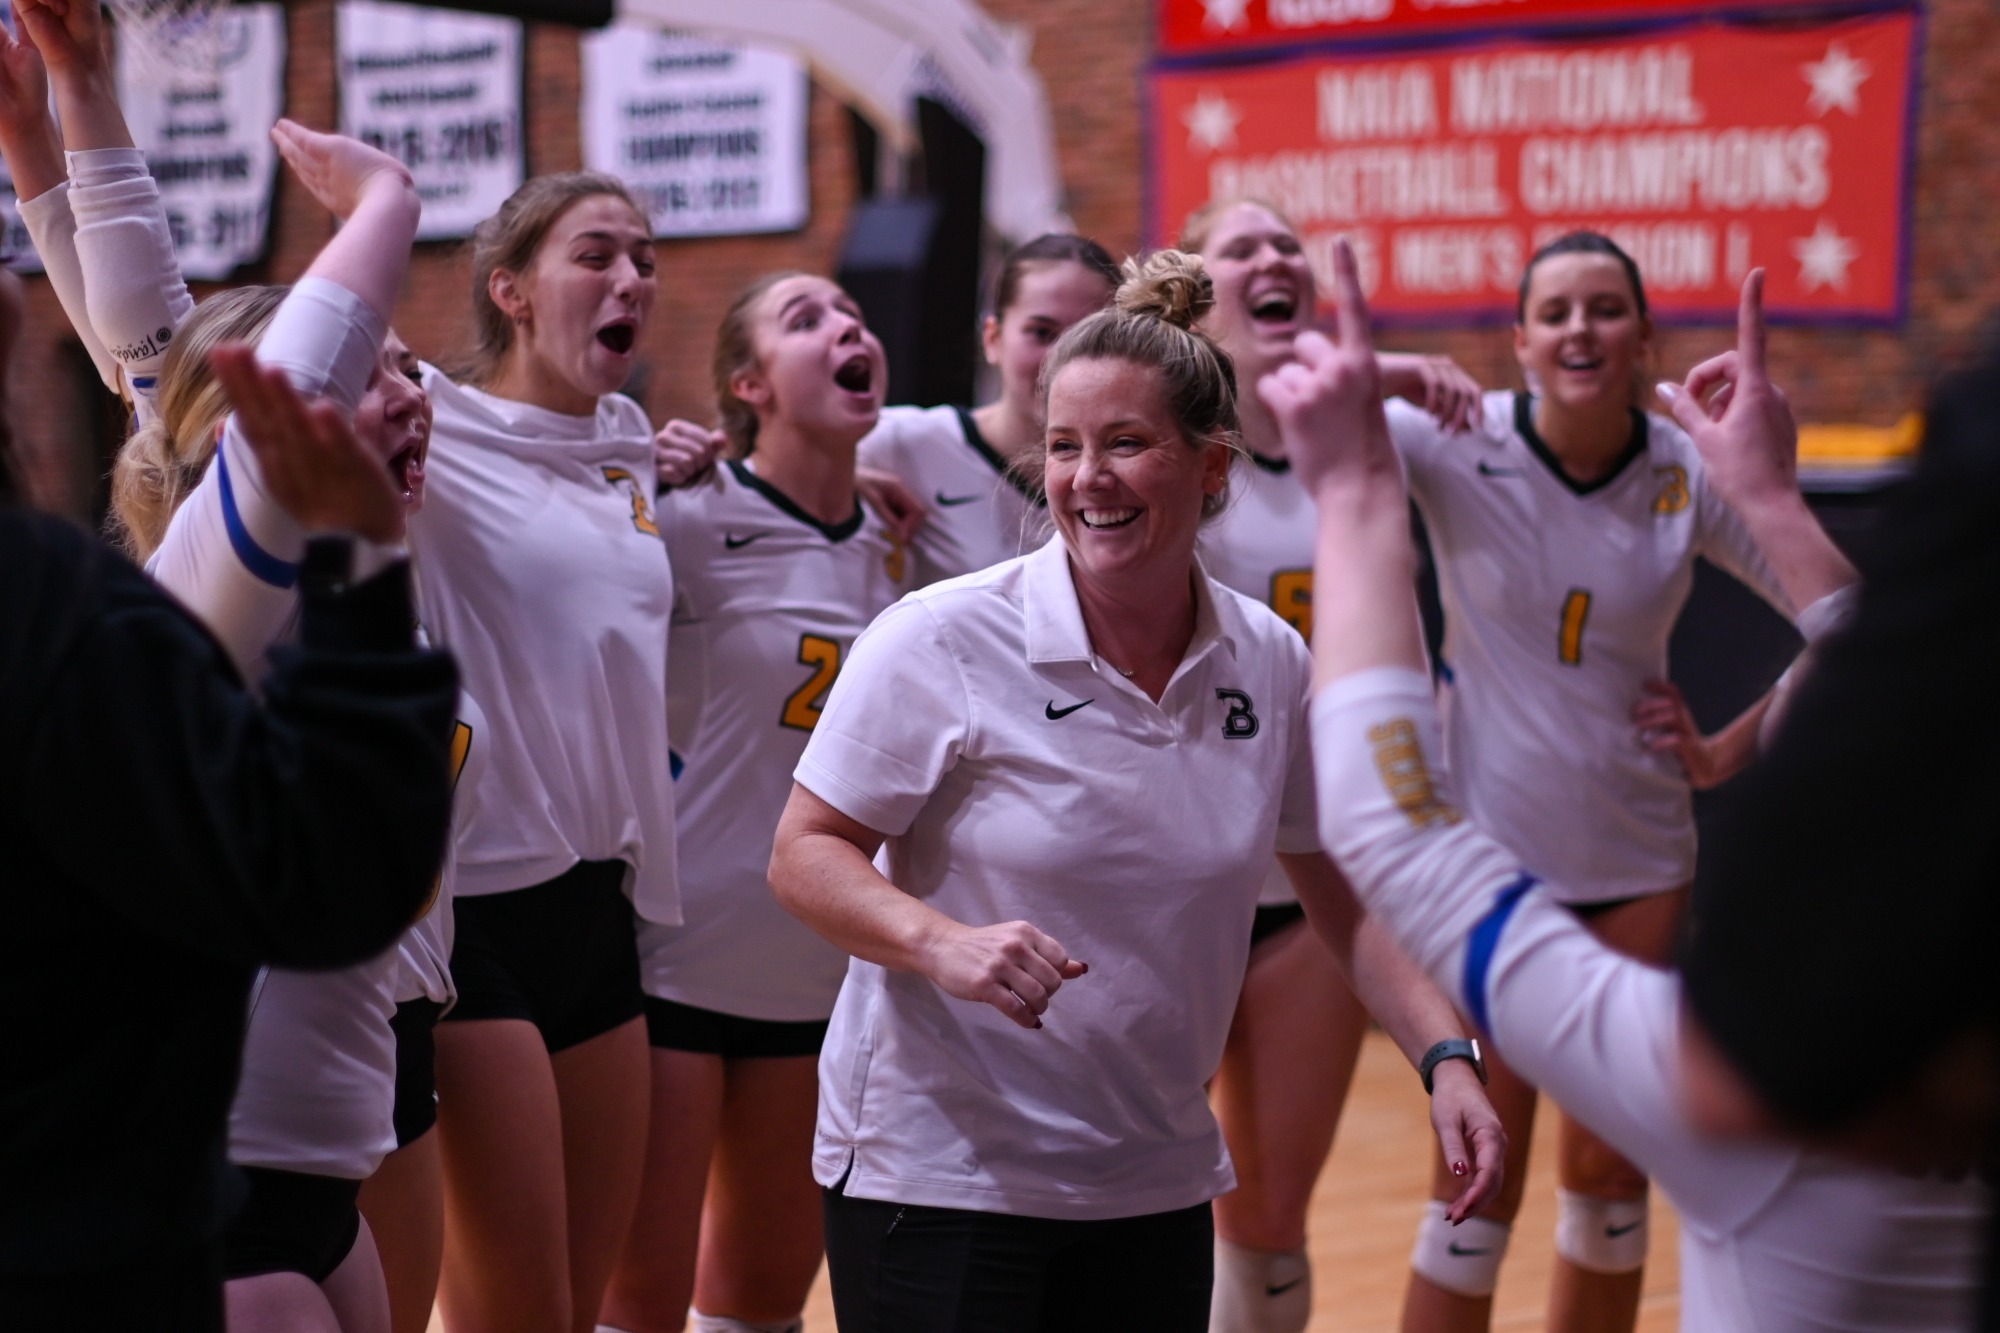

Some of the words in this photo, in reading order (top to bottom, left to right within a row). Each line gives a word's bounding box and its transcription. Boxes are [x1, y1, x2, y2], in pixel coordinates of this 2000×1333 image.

[1317, 66, 1438, 142] NAIA
[1451, 45, 1702, 133] NATIONAL
[1210, 145, 1508, 222] BASKETBALL
[1520, 126, 1828, 215] CHAMPIONS
[1392, 226, 1524, 293] MEN'S
[1558, 587, 1592, 667] 1
[1215, 687, 1260, 740] B
